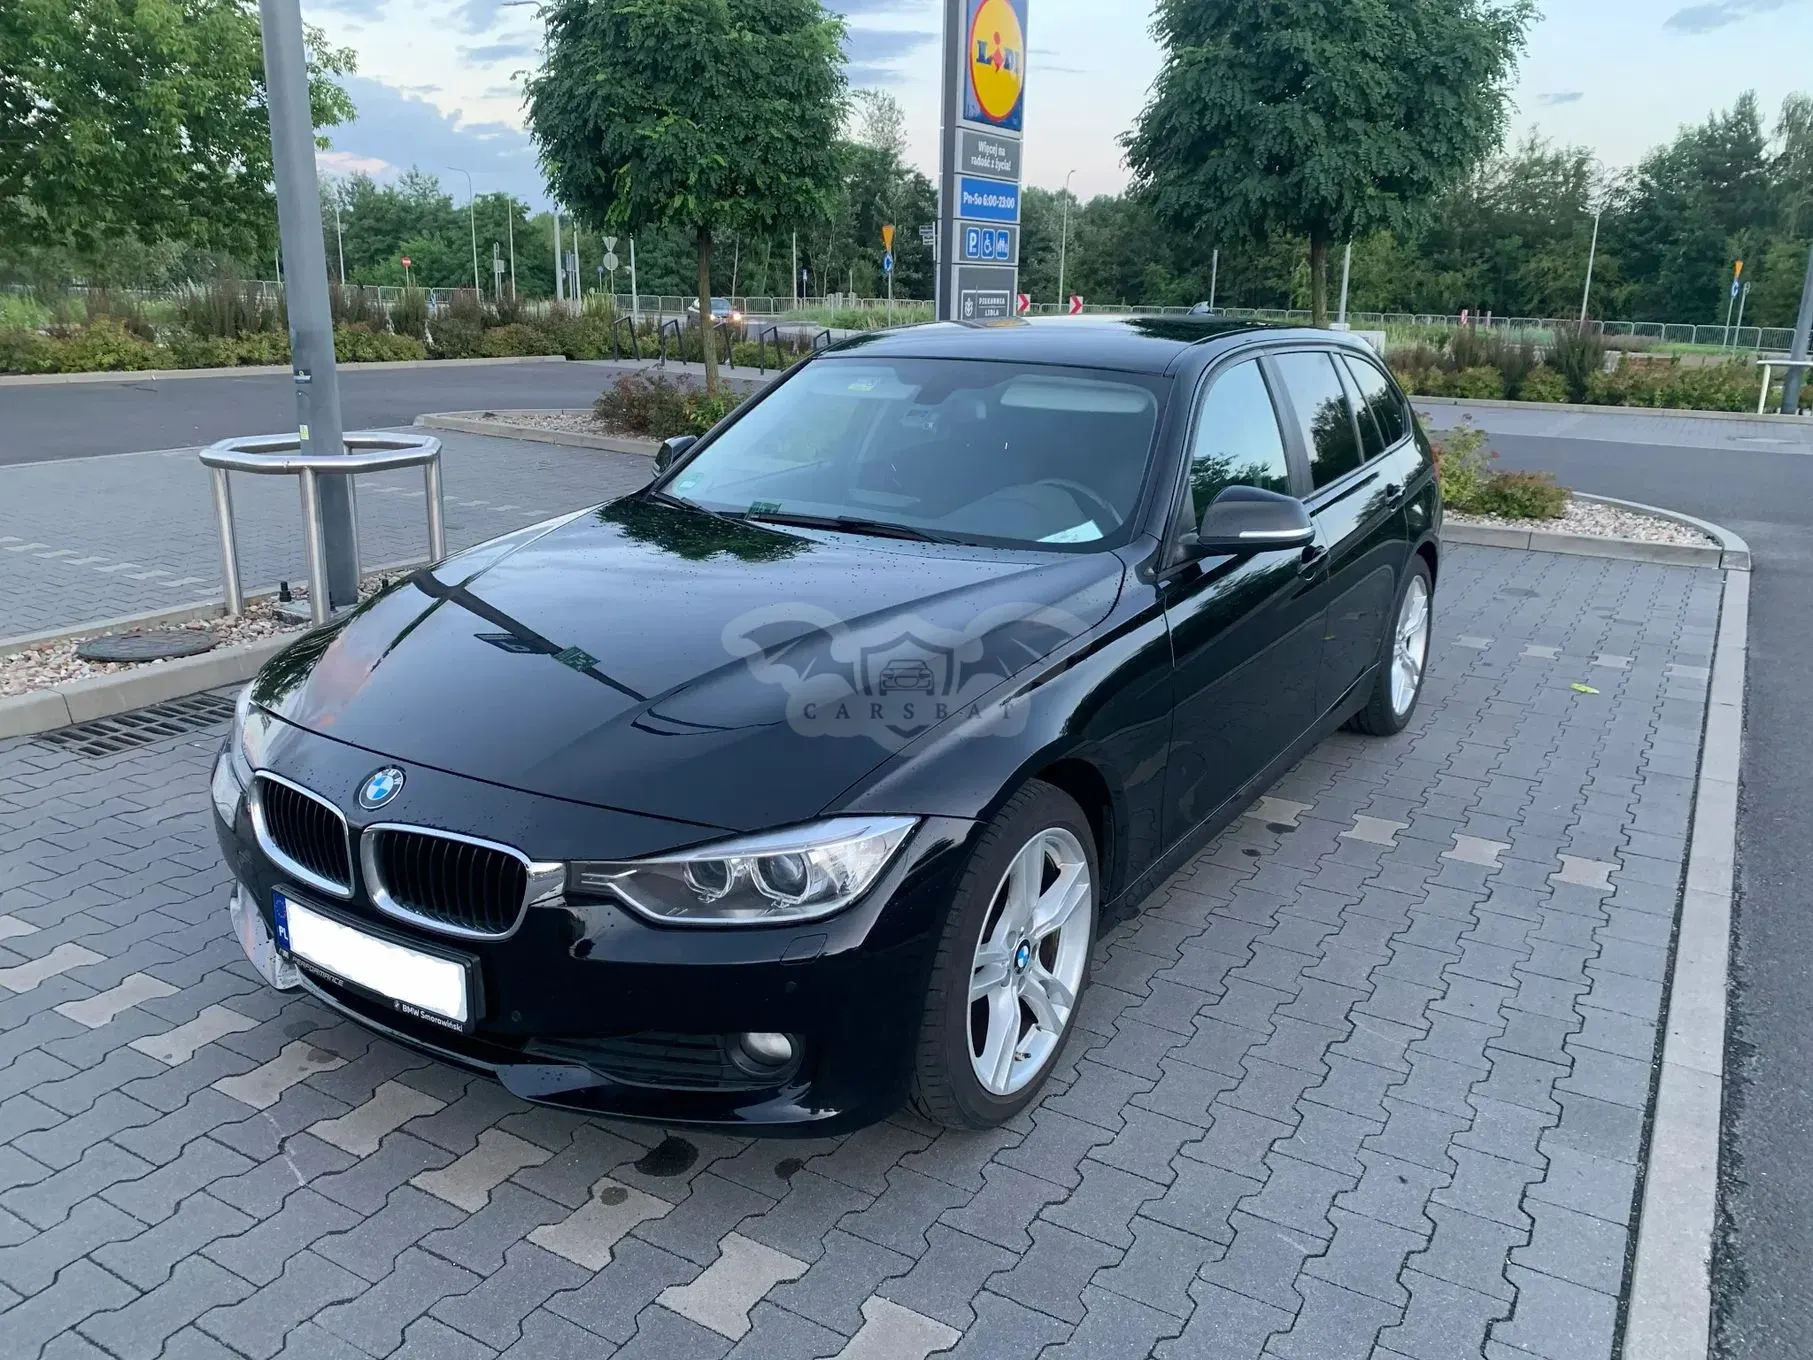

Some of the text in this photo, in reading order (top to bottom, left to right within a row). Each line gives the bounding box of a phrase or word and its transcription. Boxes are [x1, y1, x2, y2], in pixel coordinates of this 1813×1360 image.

[998, 147, 1005, 156] na
[983, 194, 1015, 208] 6:00-23:00
[969, 232, 977, 253] P
[278, 924, 289, 941] PL
[402, 1004, 420, 1017] BMW
